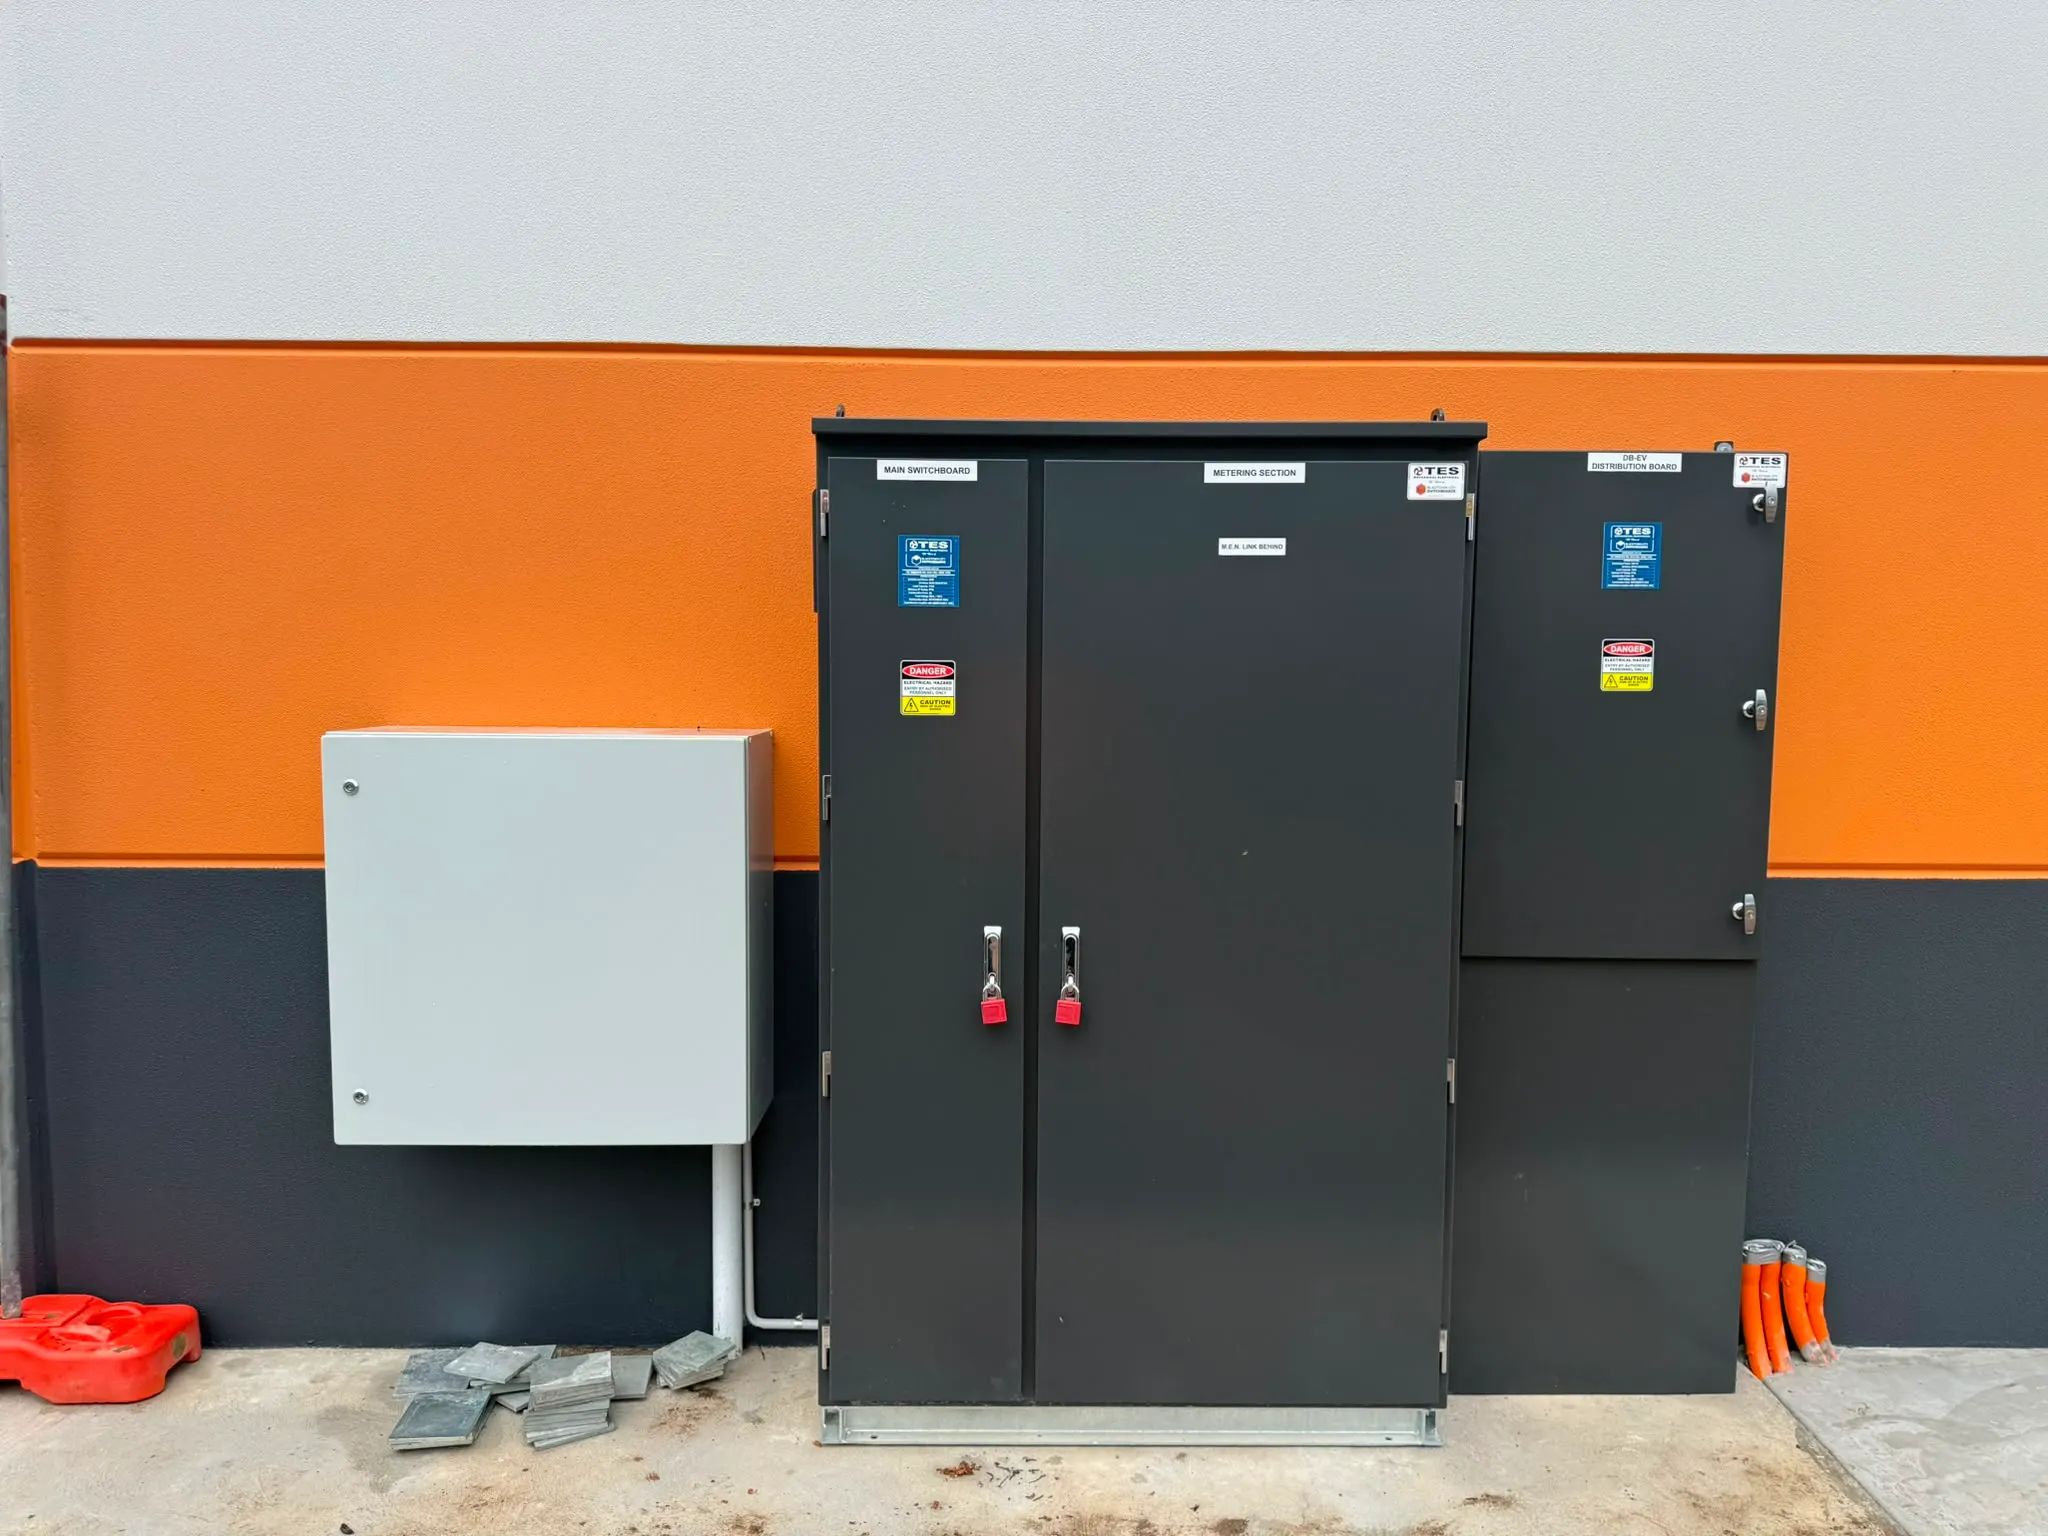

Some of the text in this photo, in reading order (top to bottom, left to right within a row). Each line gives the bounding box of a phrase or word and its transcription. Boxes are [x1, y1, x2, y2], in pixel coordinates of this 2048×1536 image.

[1749, 456, 1781, 465] TES
[1592, 462, 1647, 470] DISTRIBUTION
[907, 466, 971, 475] SWITCHBOARD
[1424, 466, 1459, 475] TES
[1622, 527, 1651, 535] TES
[918, 541, 949, 549] TES
[1610, 645, 1646, 653] DANGER
[909, 667, 947, 675] DANGER
